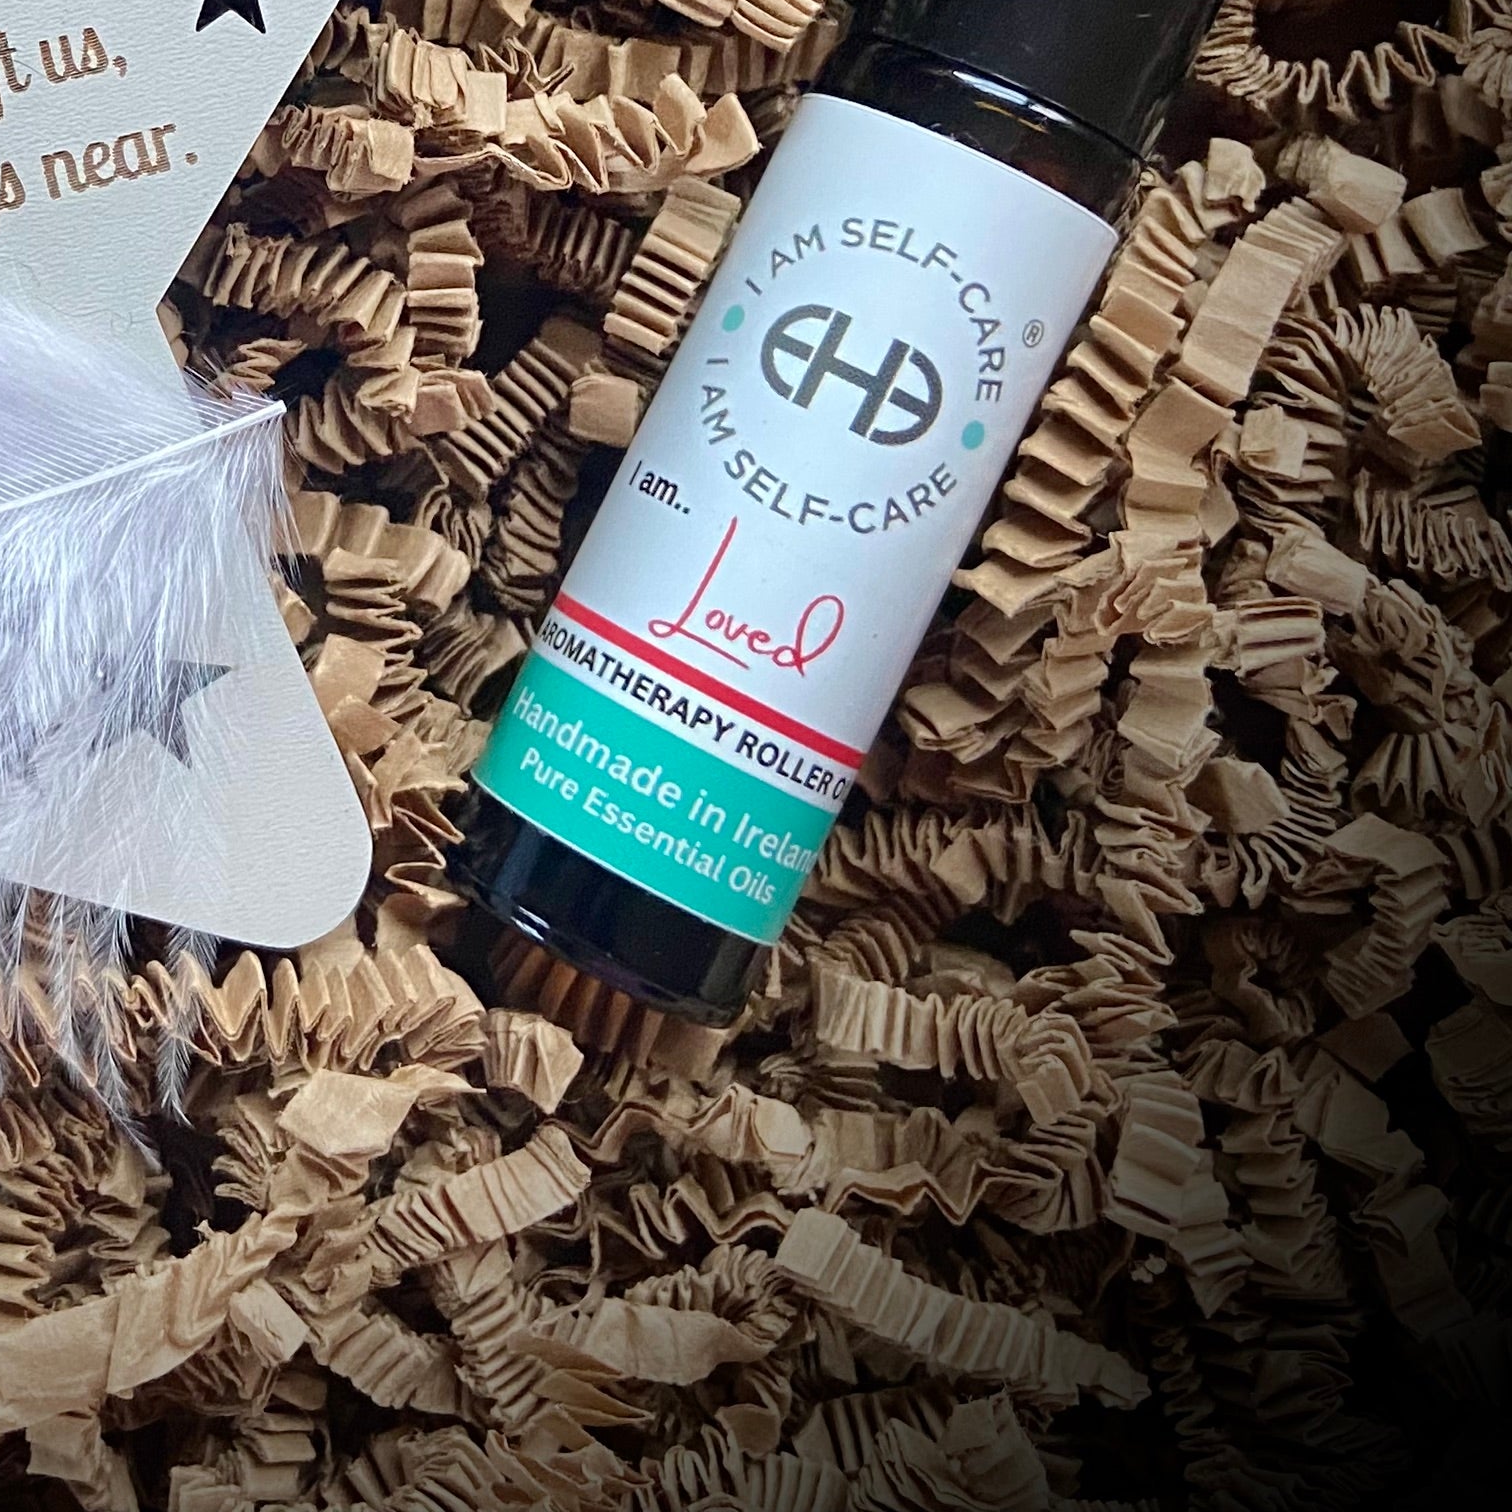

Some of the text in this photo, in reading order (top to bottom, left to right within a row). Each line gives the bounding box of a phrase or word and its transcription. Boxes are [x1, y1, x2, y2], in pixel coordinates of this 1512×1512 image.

[38, 28, 128, 84] us,
[41, 124, 199, 199] near.
[771, 224, 826, 278] AM
[841, 217, 1006, 403] SELF-CARE
[629, 460, 642, 485] I
[701, 384, 737, 445] AM
[723, 449, 958, 534] SELF-CARE
[648, 515, 845, 677] Loved
[512, 686, 818, 874] Handmade in Irelan
[539, 618, 734, 743] AROMATHERAPY
[735, 729, 834, 795] ROLLER
[519, 746, 777, 906] Pure Essential Oils
